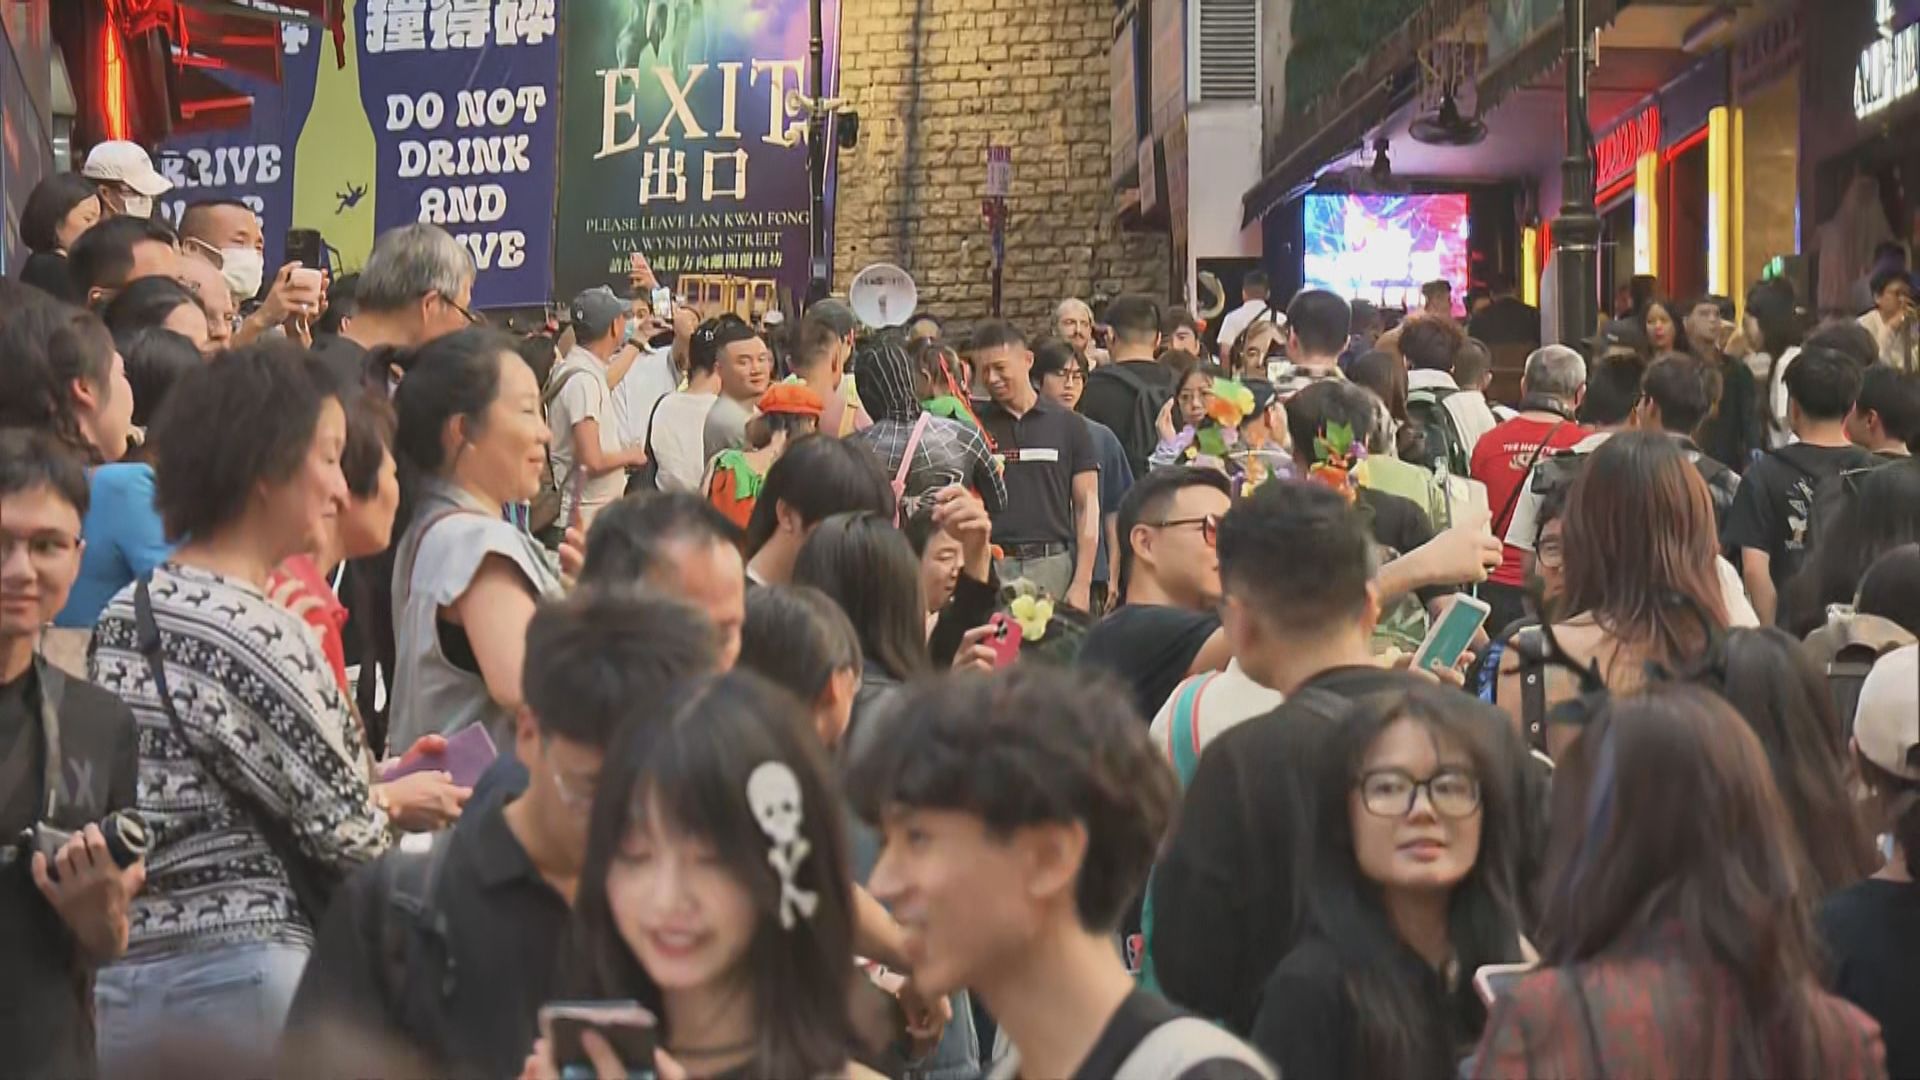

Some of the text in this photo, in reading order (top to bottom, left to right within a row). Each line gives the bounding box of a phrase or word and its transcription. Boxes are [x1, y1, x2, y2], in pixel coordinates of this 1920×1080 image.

[386, 86, 547, 131] DO NOT
[593, 58, 806, 159] EXIT
[160, 144, 282, 188] RRIVE
[397, 134, 531, 177] DRINK
[639, 147, 748, 205] 出口
[417, 184, 507, 223] AND
[586, 210, 810, 233] PLEASE LEAVE LAN KWAI FONG
[611, 231, 784, 251] VIA WYNDHAM STREET
